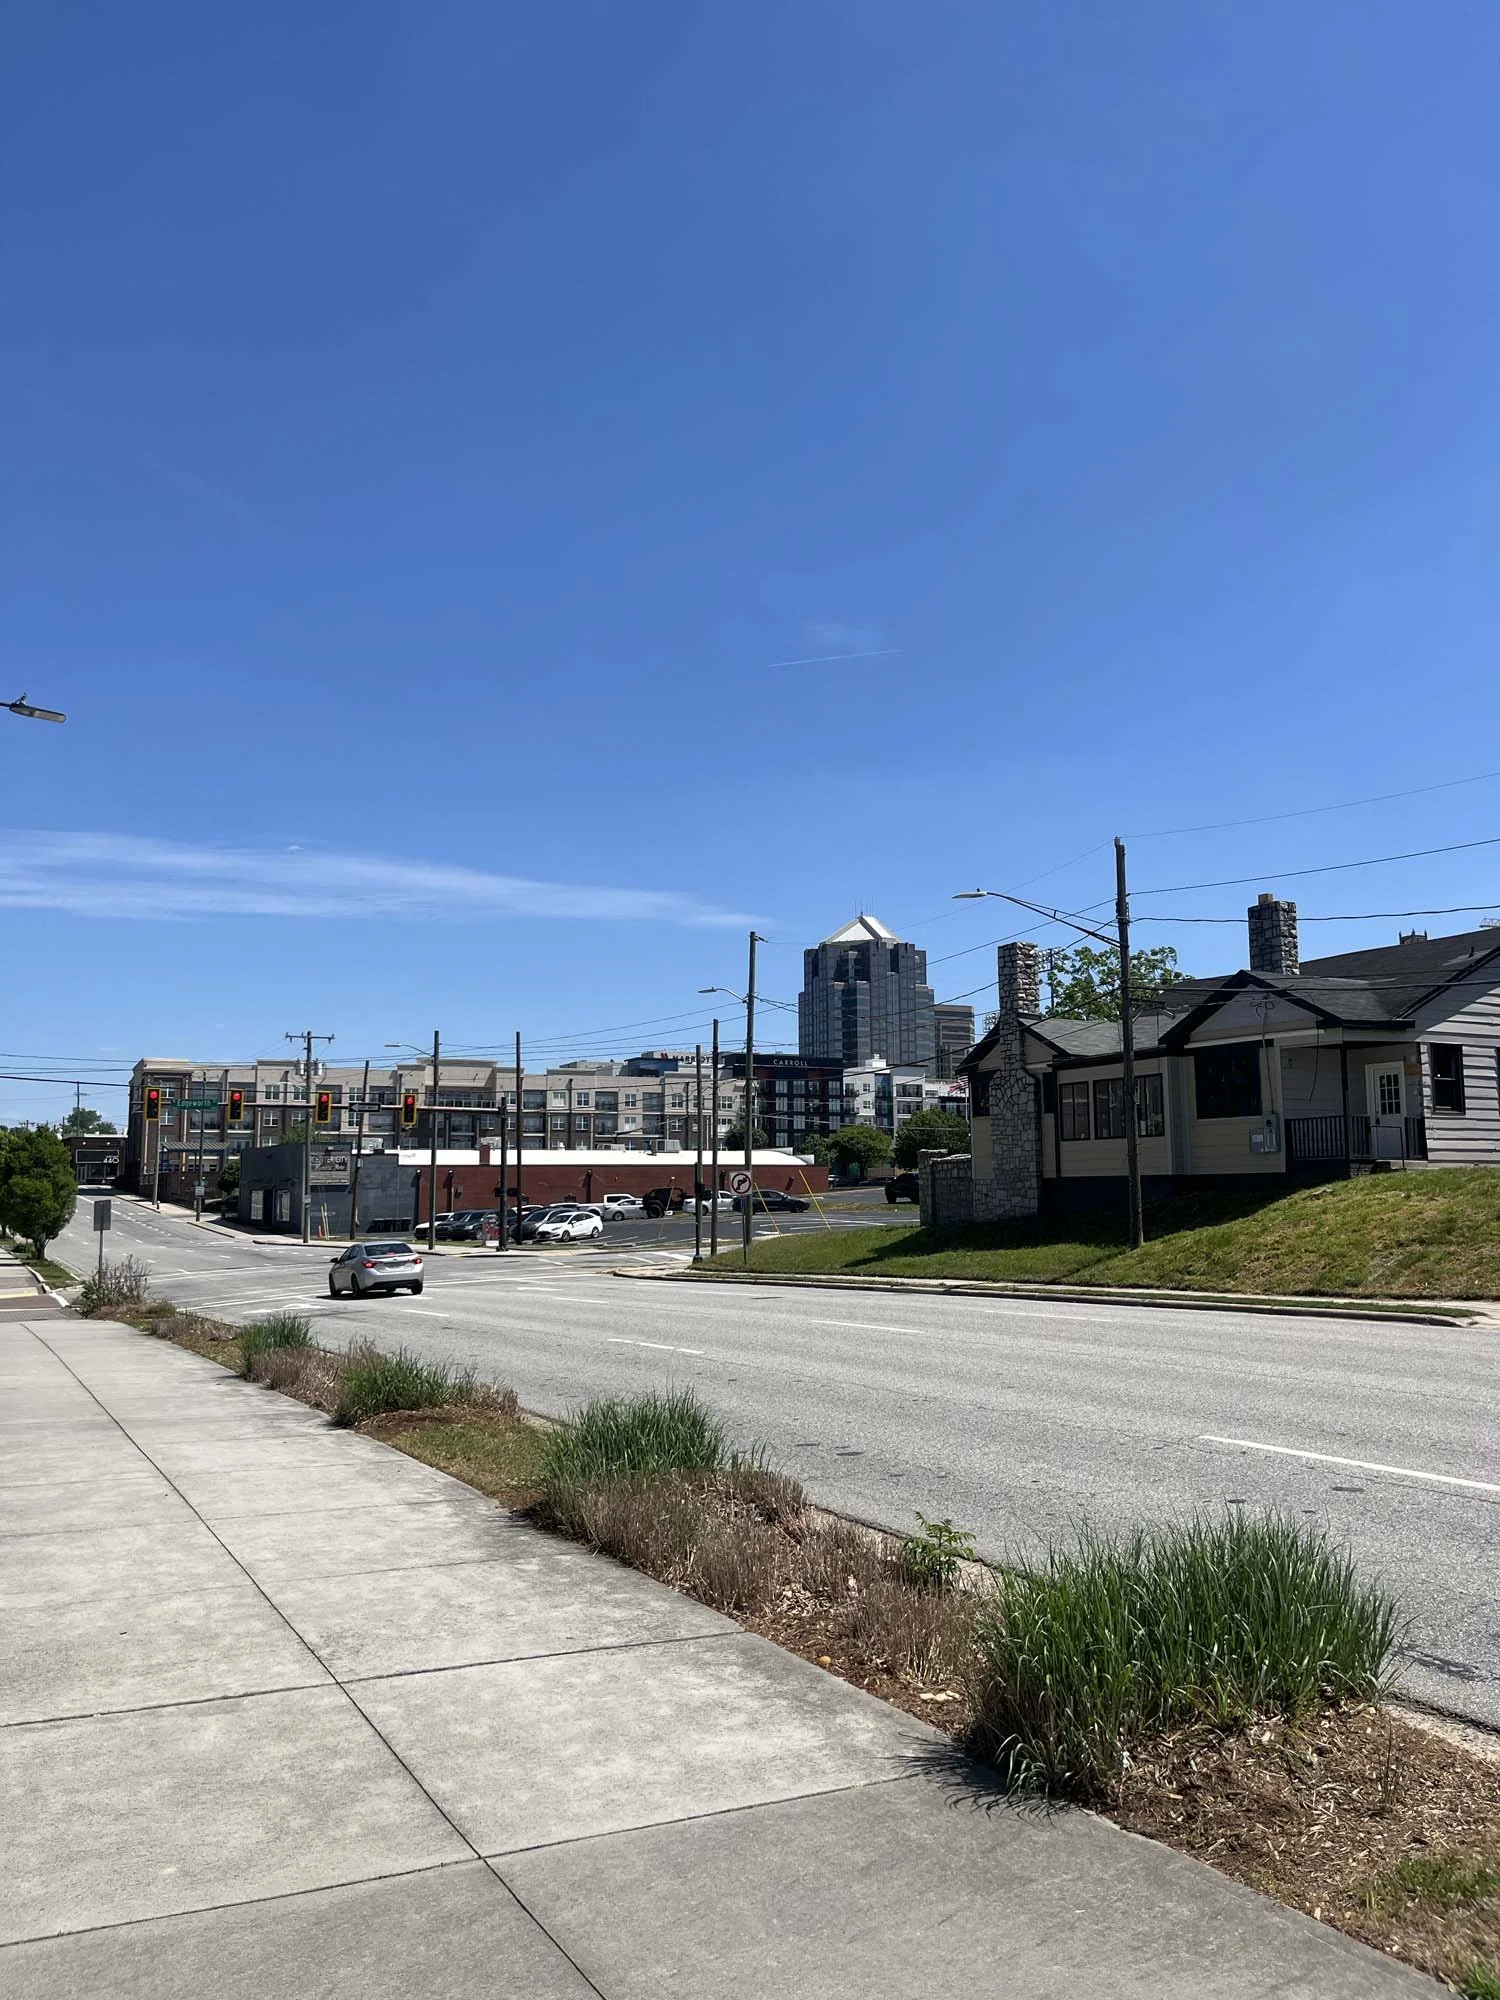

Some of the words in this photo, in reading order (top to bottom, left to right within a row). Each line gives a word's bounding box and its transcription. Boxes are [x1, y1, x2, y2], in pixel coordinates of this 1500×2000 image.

[673, 1056, 714, 1064] MARROT
[773, 1058, 808, 1066] CARROLL
[176, 1099, 211, 1108] Edgeworth
